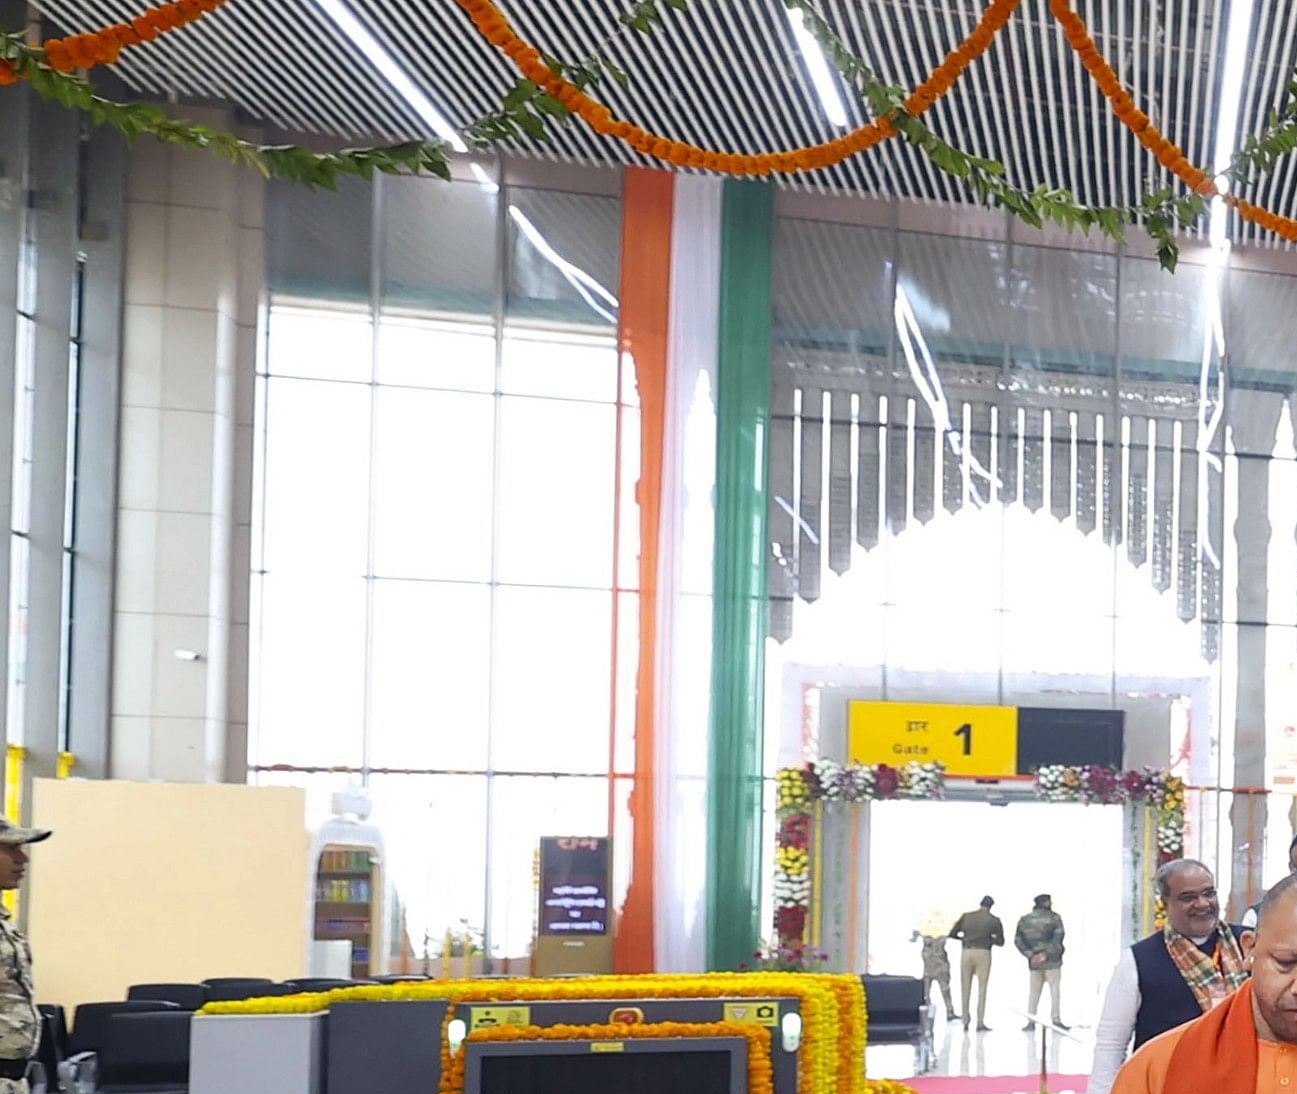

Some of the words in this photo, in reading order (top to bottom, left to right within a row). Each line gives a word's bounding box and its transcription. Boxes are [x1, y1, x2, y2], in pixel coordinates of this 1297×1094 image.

[905, 719, 929, 733] द्वार
[953, 723, 972, 756] 1
[891, 743, 929, 755] Gate
